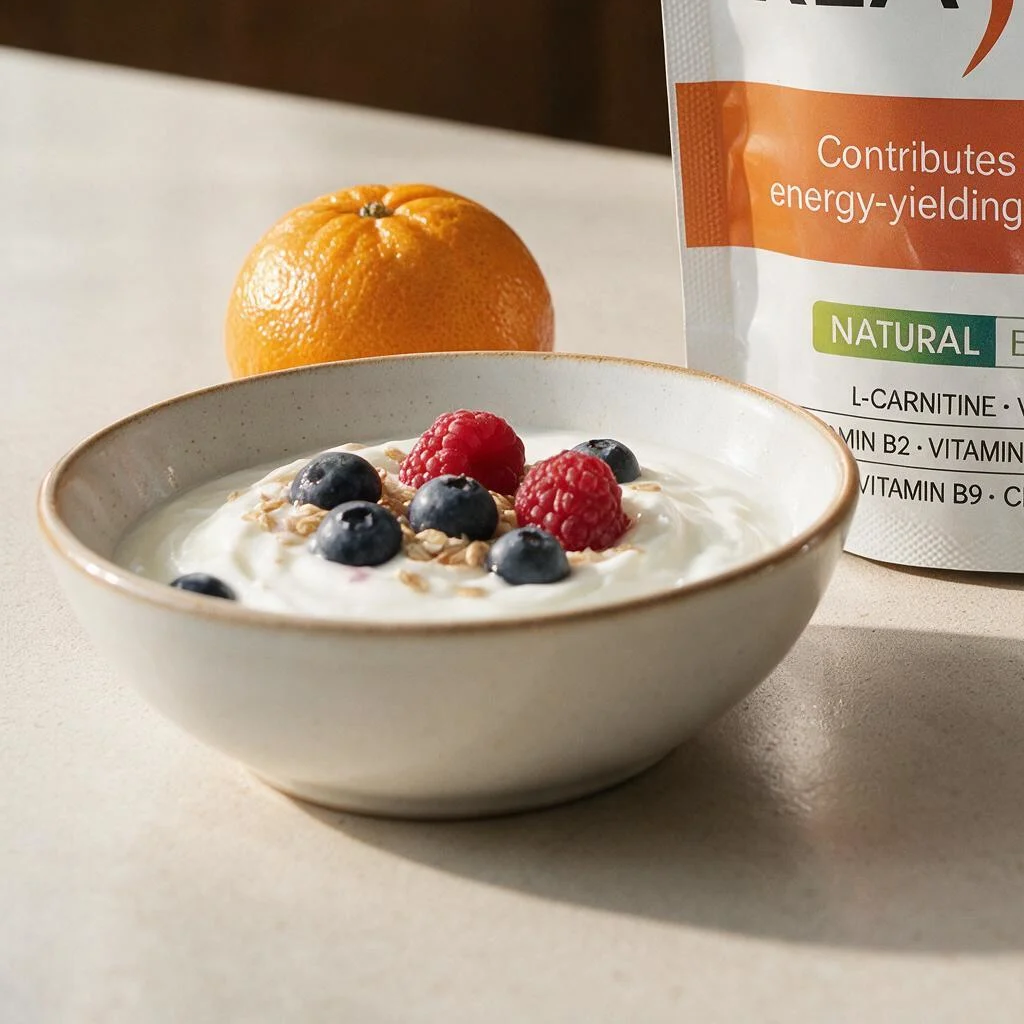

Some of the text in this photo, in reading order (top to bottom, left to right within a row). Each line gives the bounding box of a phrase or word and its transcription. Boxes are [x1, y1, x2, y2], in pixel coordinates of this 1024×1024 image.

[817, 134, 1016, 177] Contributes
[770, 182, 1022, 231] energy-yielding
[831, 315, 980, 356] NATURAL
[852, 386, 997, 417] L-CARNITINE
[829, 425, 875, 452] MIN
[883, 433, 910, 456] B2
[928, 437, 1023, 464] VITAMIN
[859, 475, 945, 503] VITAMIN
[953, 483, 982, 505] B9
